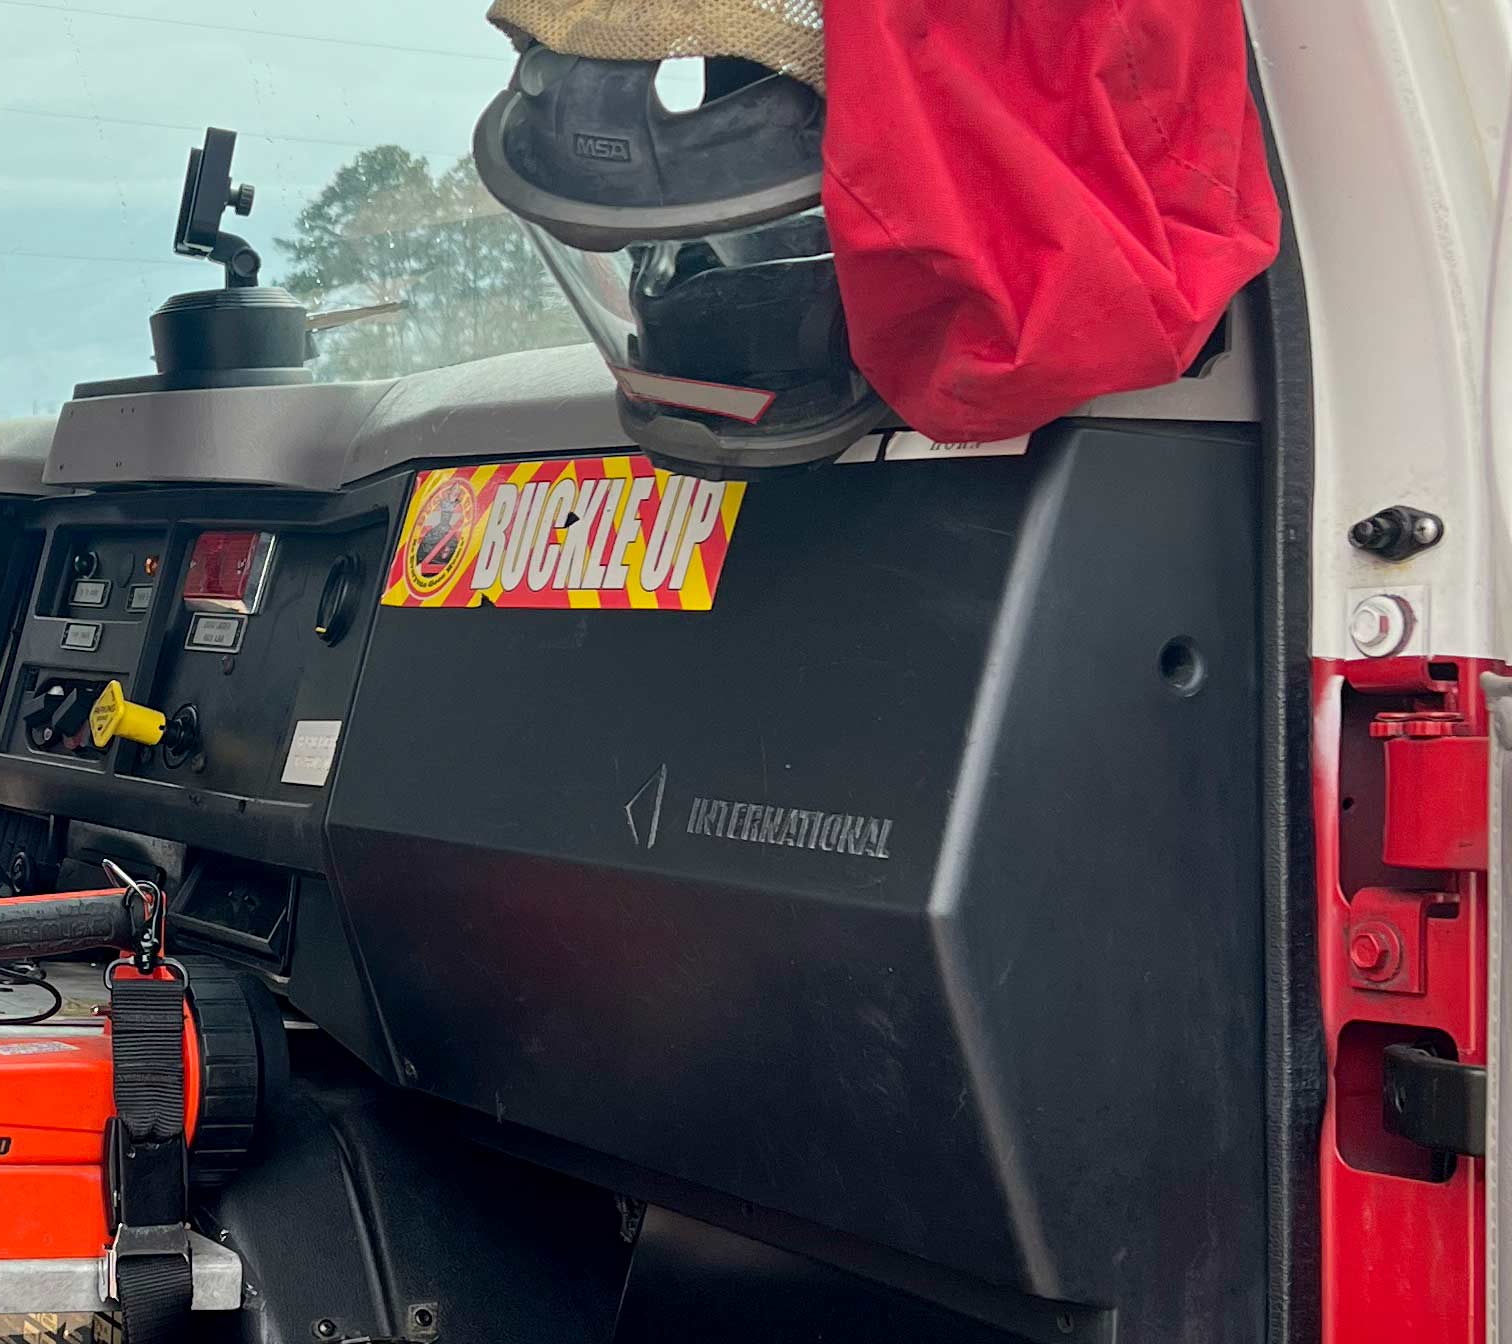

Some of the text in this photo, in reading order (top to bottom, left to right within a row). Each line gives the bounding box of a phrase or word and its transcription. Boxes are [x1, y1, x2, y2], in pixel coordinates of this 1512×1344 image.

[576, 136, 629, 161] MSA
[470, 476, 657, 592] BUCKLE
[638, 473, 728, 592] UP
[686, 796, 895, 860] INTERNATIONAL
